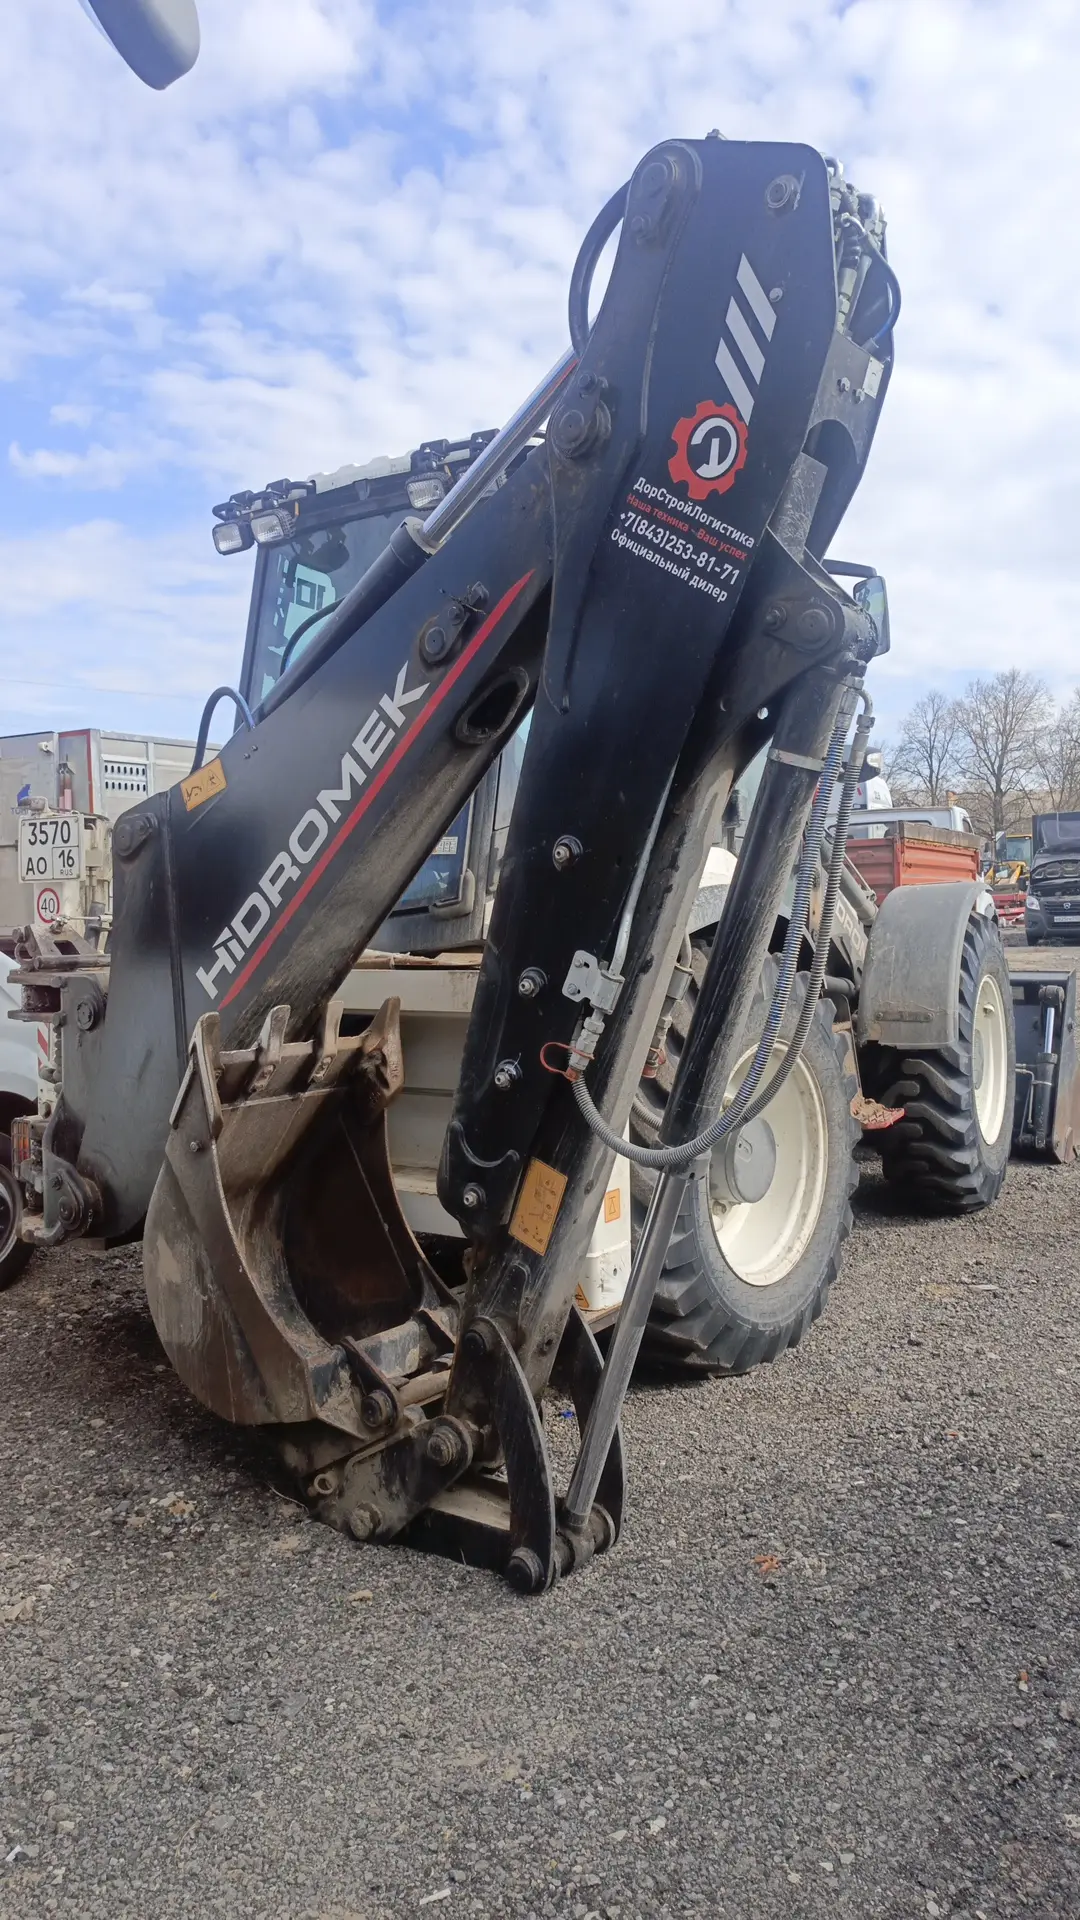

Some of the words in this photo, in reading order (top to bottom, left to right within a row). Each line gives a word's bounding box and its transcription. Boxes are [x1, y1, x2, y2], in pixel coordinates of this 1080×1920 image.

[626, 492, 652, 514] Наша
[653, 506, 689, 532] техника
[696, 529, 718, 547] Ваш
[718, 541, 748, 561] успех
[633, 476, 755, 548] ДорСтройЛогистика
[611, 528, 691, 581] Официальный
[688, 575, 728, 603] дилер
[619, 510, 740, 585] +7(843)253-81-71
[28, 820, 71, 846] 3570
[58, 849, 75, 868] 16
[41, 897, 56, 914] 40
